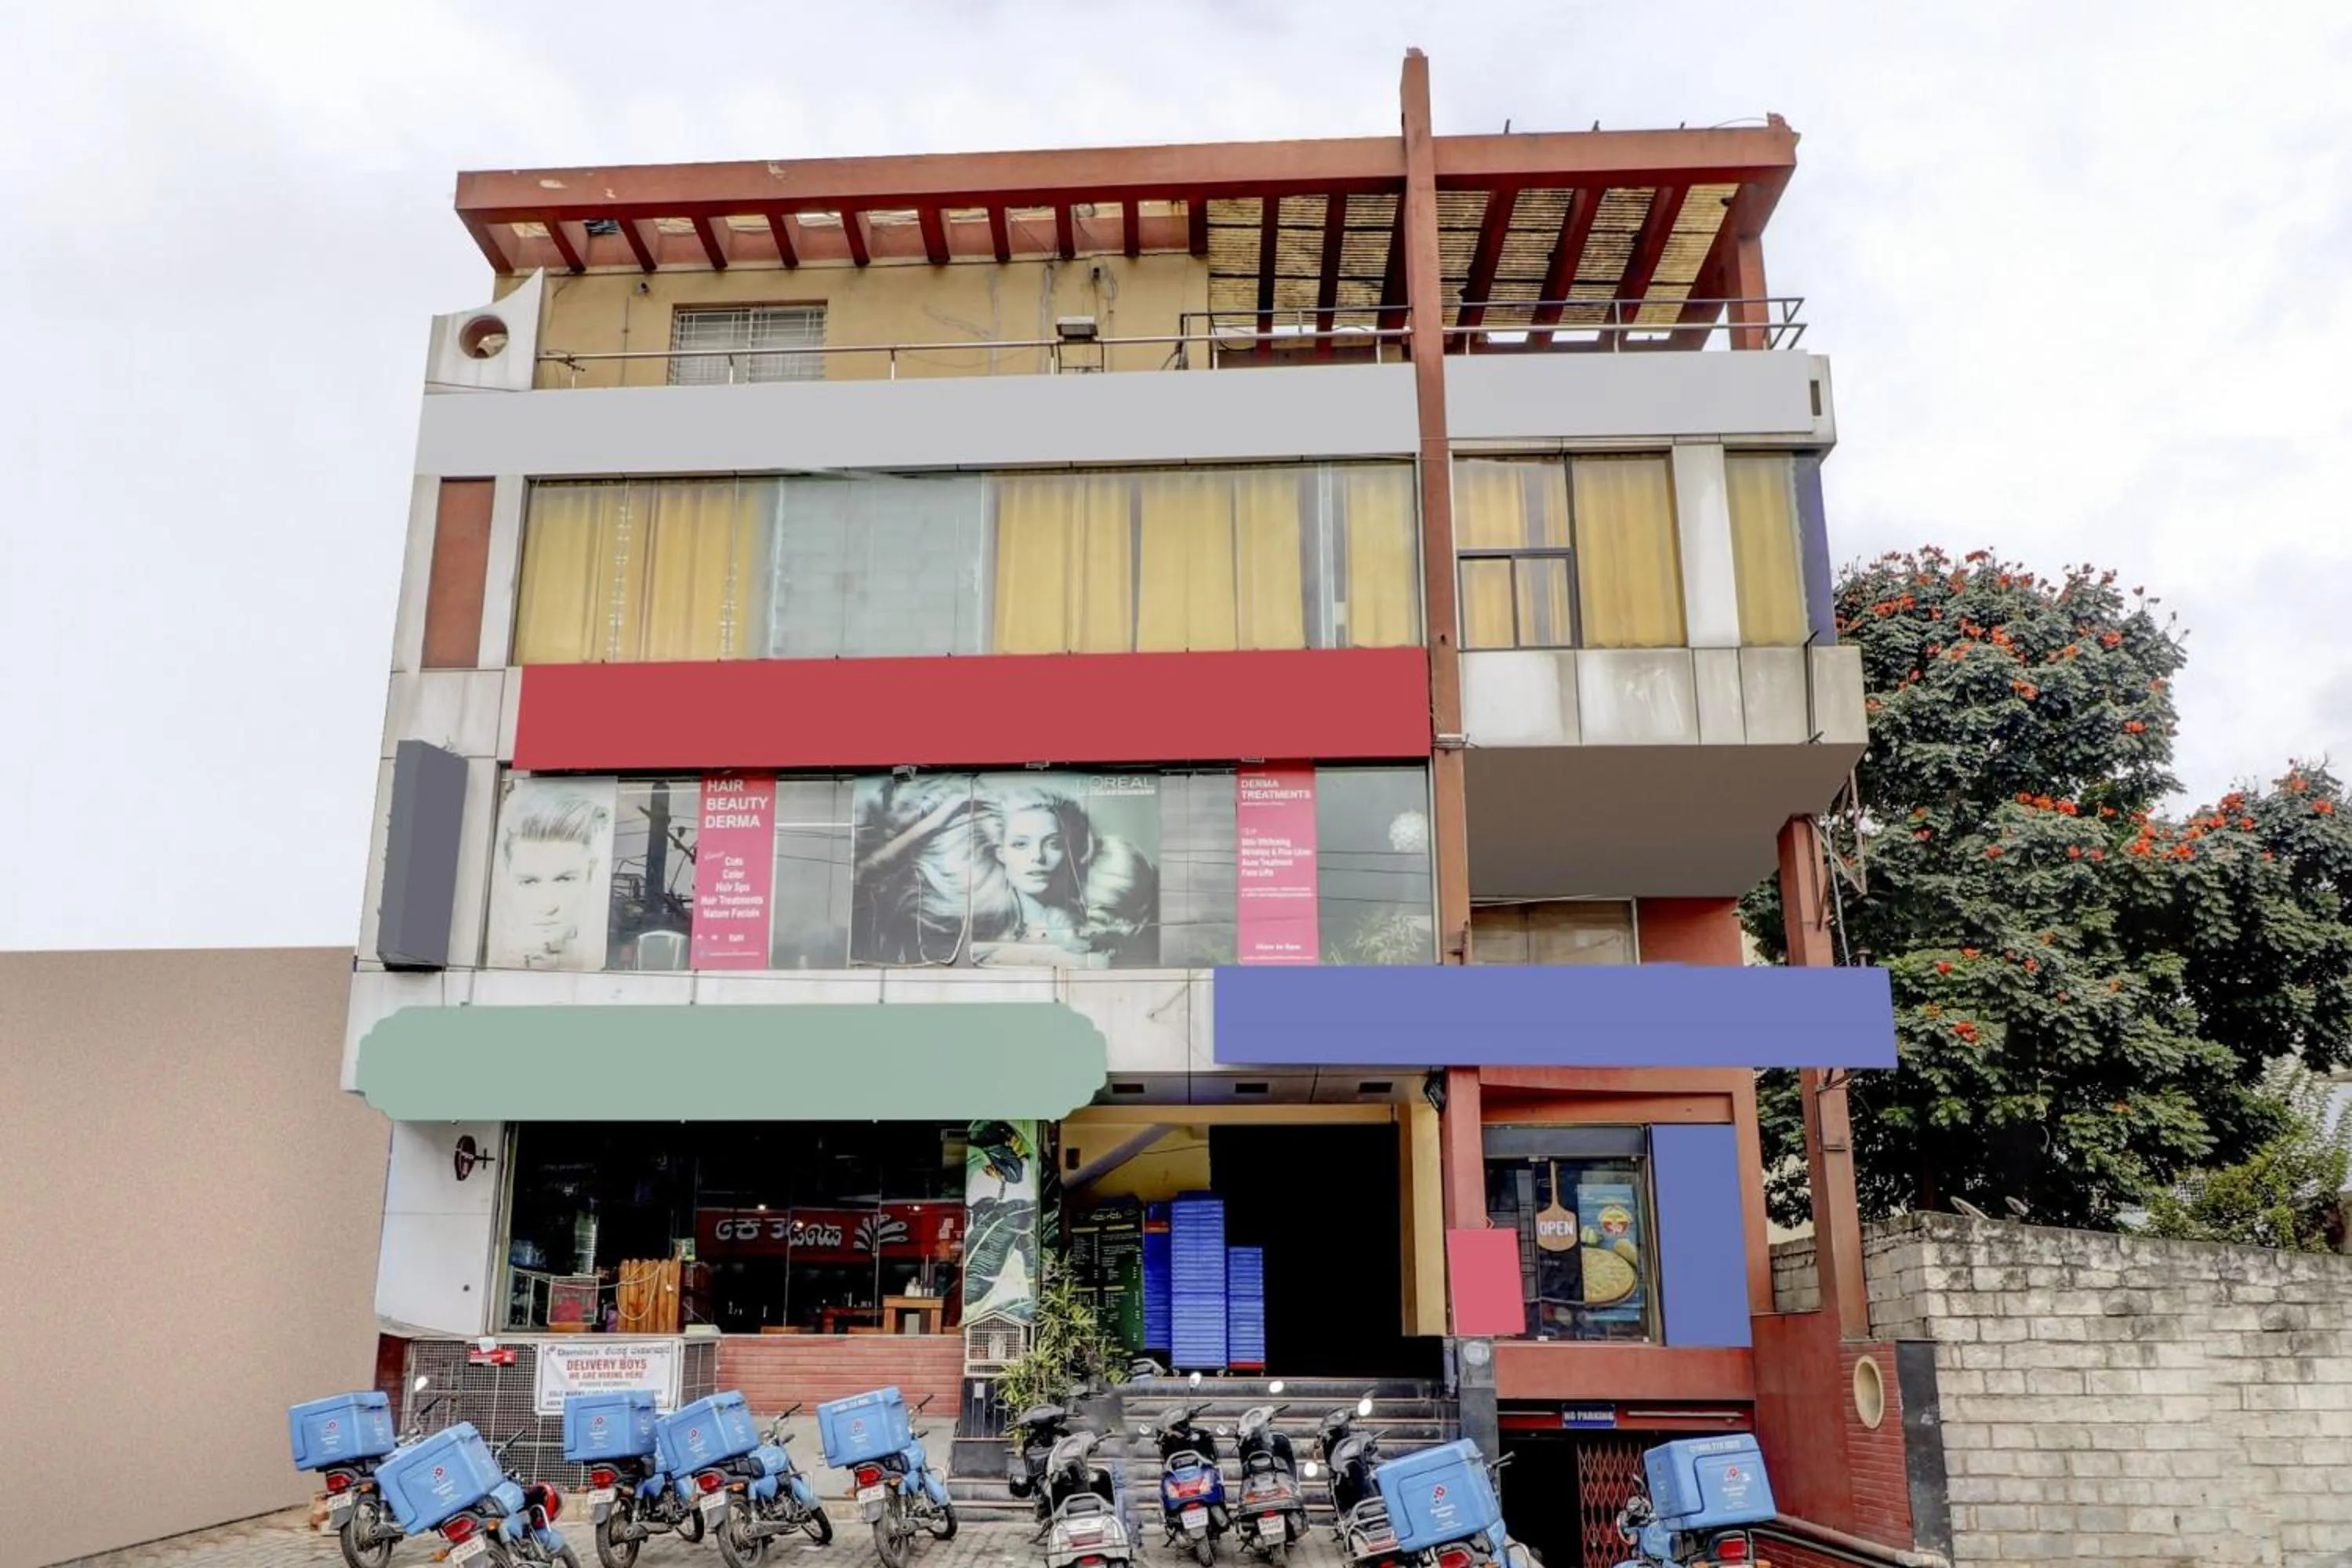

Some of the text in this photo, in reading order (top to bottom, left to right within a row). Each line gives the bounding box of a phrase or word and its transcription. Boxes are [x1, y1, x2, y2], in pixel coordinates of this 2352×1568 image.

[707, 780, 744, 792] HAIR
[1241, 779, 1279, 789] DERMA
[1241, 789, 1312, 800] TREATMENTS
[706, 797, 768, 811] BEAUTY
[706, 815, 760, 829] DERMA
[722, 869, 745, 879] Color
[715, 881, 750, 893] Hair Spa
[1539, 1221, 1573, 1236] OPEN
[567, 1359, 647, 1370] DELIVERY BOYS
[582, 1371, 596, 1380] ARE
[1564, 1411, 1614, 1421] NO PARKING
